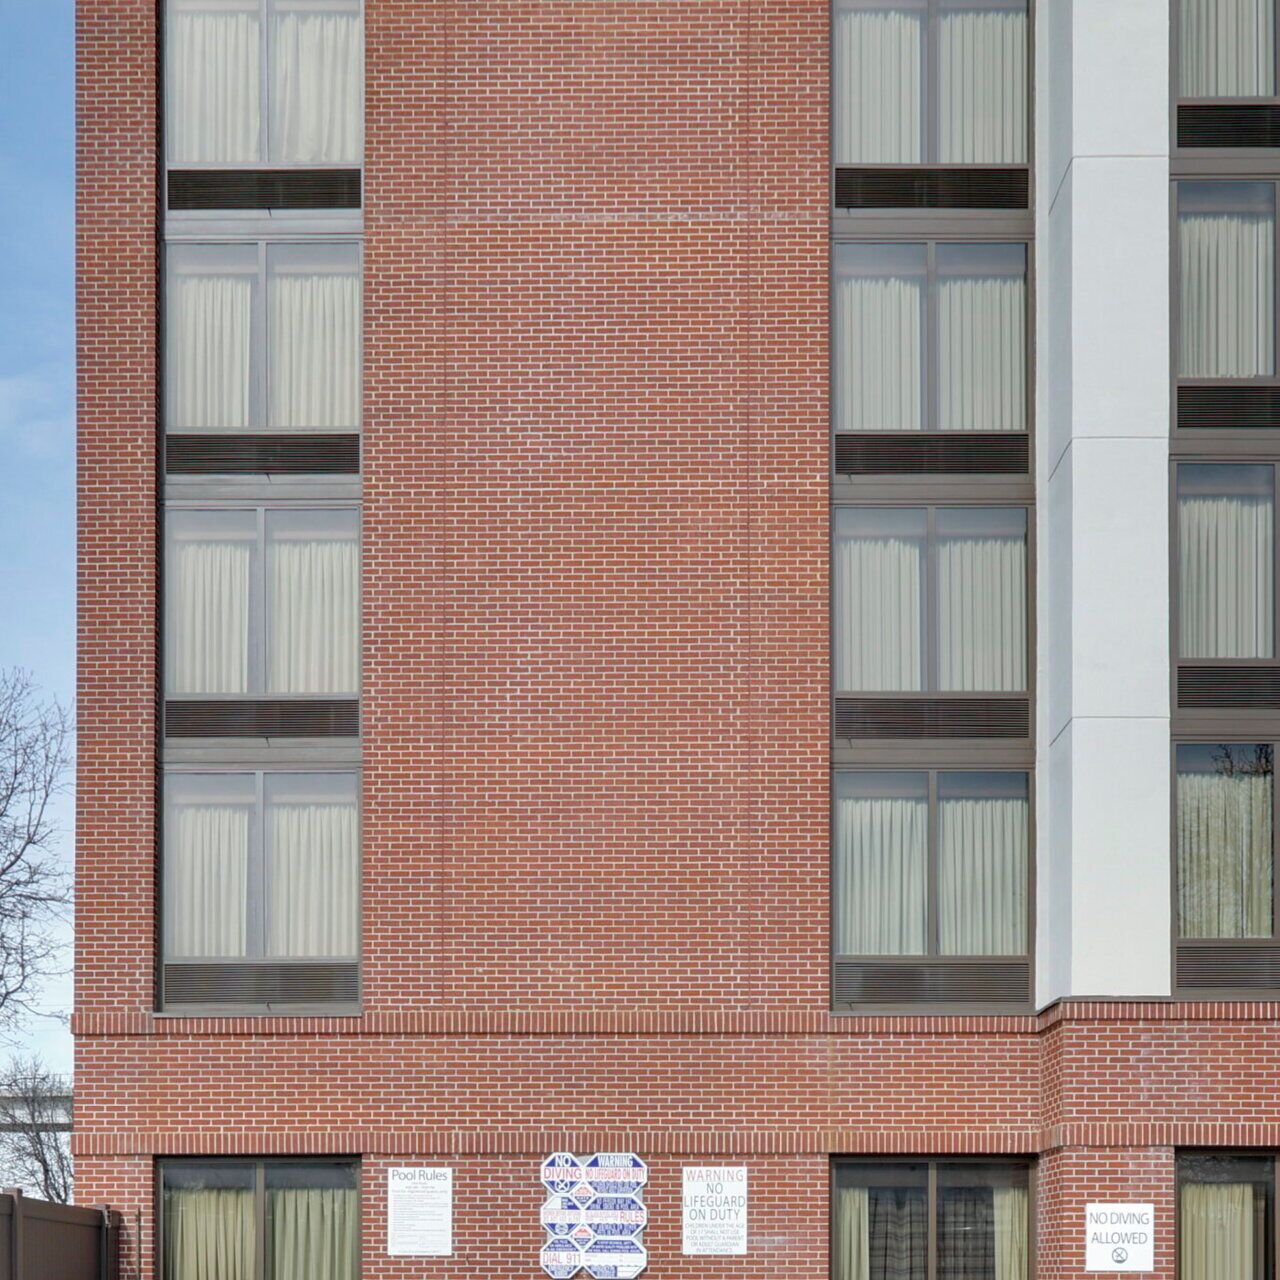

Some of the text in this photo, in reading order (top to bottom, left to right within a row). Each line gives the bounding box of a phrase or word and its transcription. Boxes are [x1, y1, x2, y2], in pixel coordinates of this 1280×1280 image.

[554, 1155, 571, 1167] NO
[598, 1155, 634, 1167] WARNING
[391, 1169, 448, 1181] Pool Rules
[543, 1168, 581, 1180] DIVING
[585, 1168, 645, 1180] NO LIFEGUARD ON DUTY
[686, 1169, 744, 1181] WARNING
[706, 1182, 723, 1194] NO
[684, 1195, 745, 1207] LIFEGUARD
[620, 1211, 645, 1222] RULES
[689, 1208, 740, 1220] ON DUTY
[1089, 1212, 1150, 1225] NO DIVING
[1091, 1231, 1148, 1245] ALLOWED
[543, 1252, 562, 1264] DIAL
[567, 1252, 580, 1264] 911
